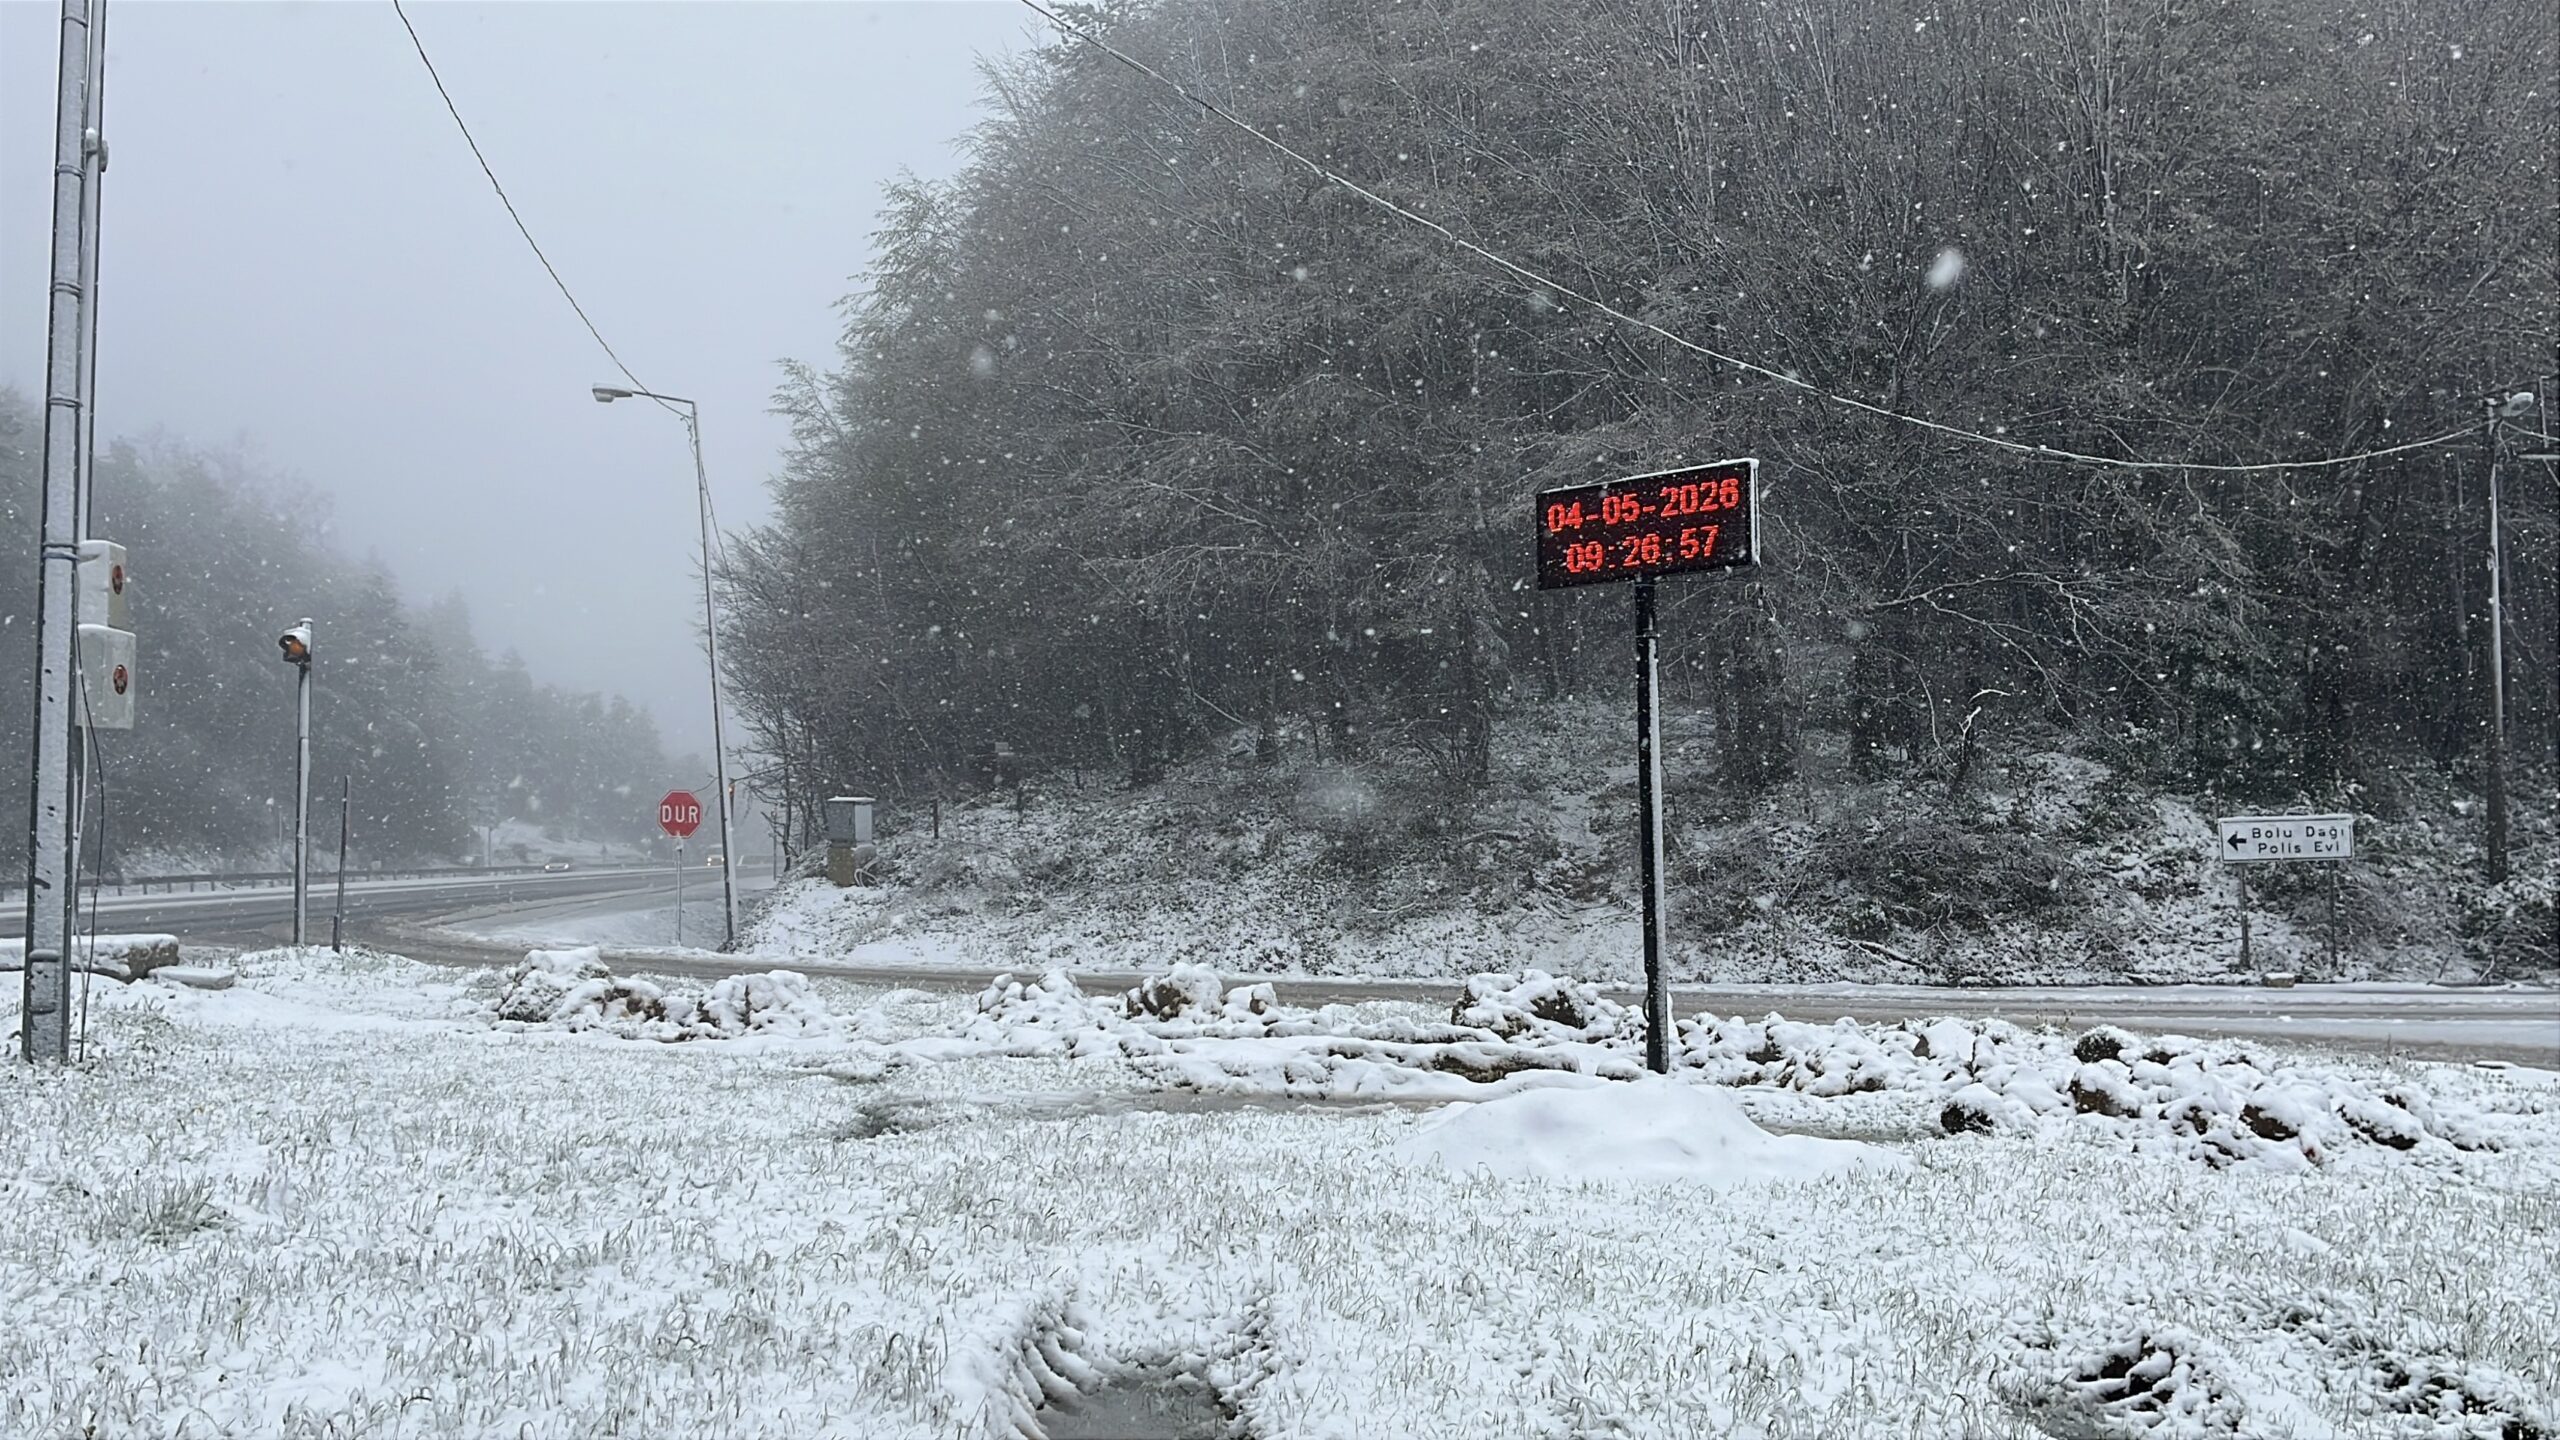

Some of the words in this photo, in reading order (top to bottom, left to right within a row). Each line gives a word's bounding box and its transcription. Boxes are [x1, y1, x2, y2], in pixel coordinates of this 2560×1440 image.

[1547, 478, 1739, 532] 04-05-2026
[1566, 525, 1719, 573] 09:26:57
[662, 805, 698, 823] DUR
[2252, 827, 2292, 838] Bolu
[2258, 842, 2301, 854] Polis
[2314, 841, 2339, 852] Evi
